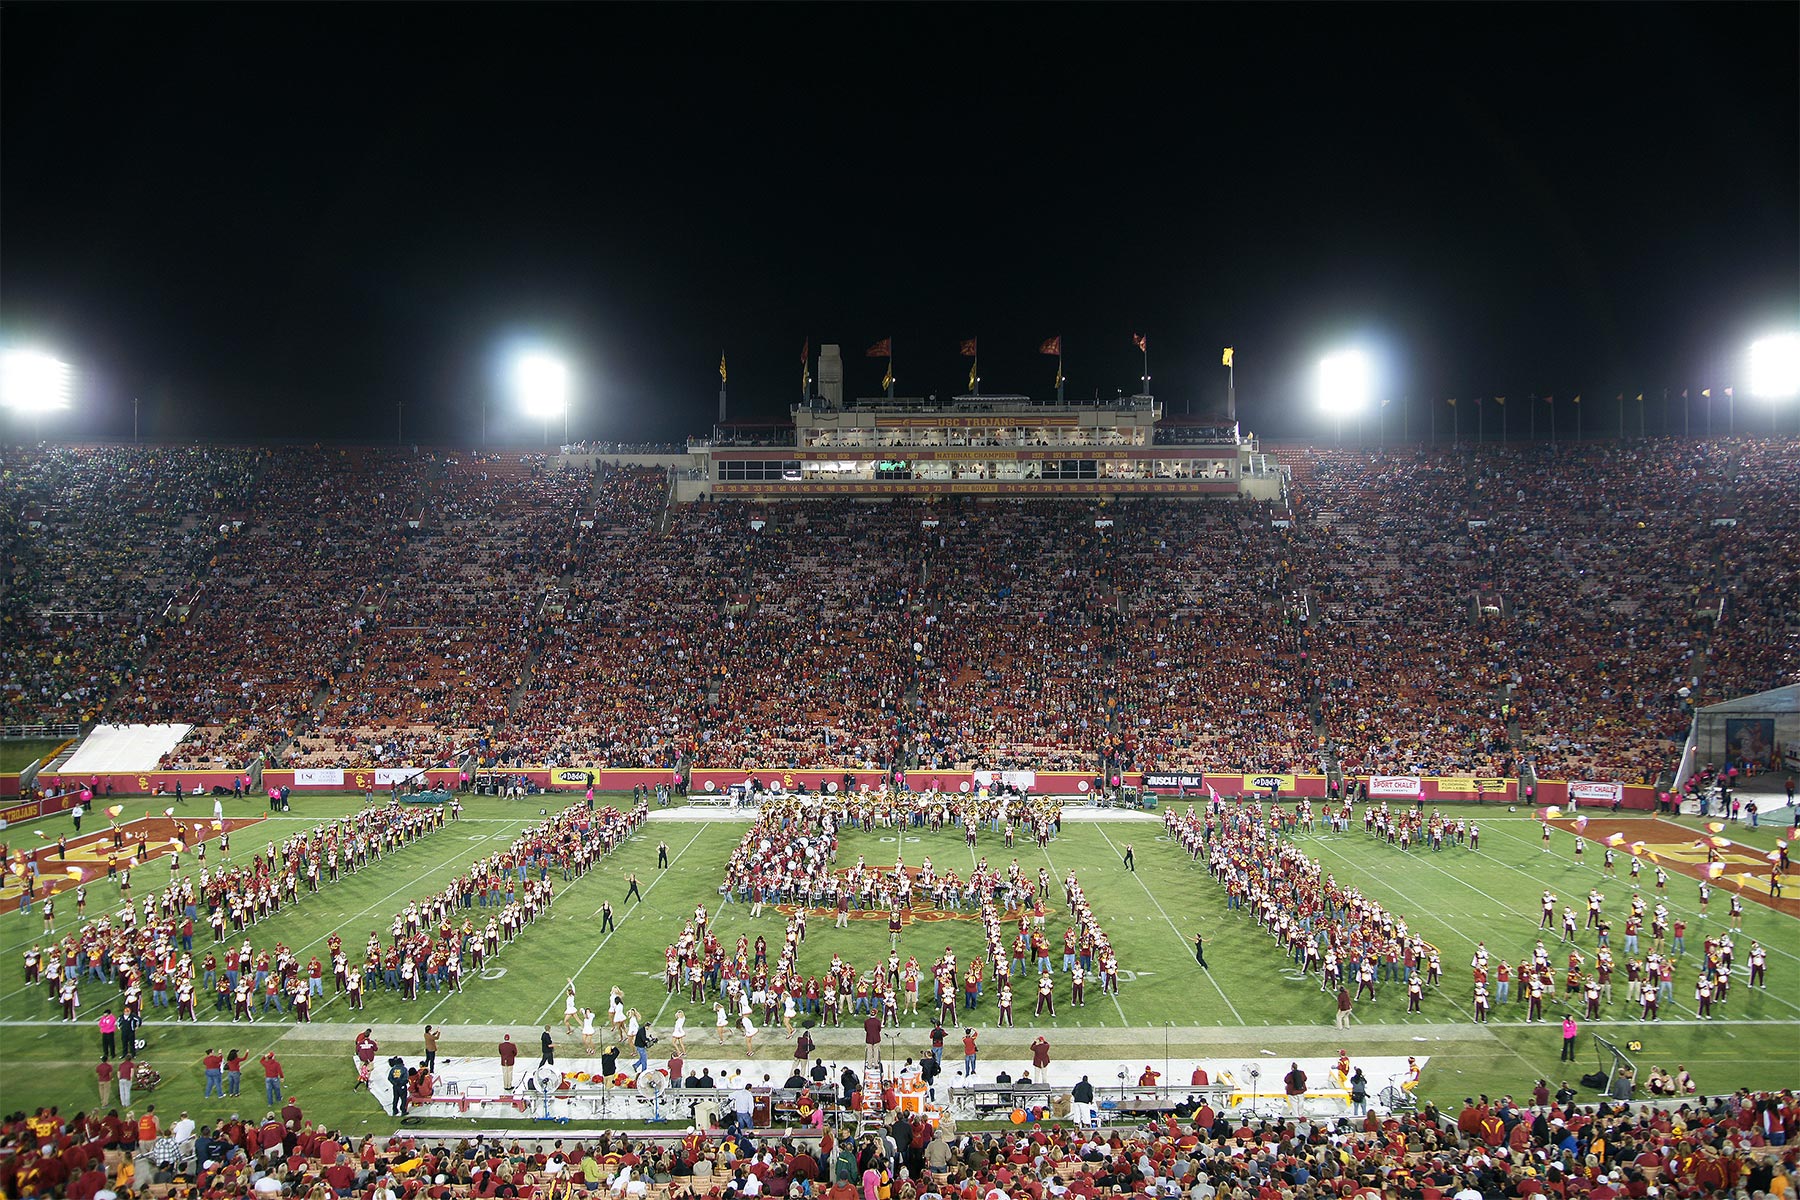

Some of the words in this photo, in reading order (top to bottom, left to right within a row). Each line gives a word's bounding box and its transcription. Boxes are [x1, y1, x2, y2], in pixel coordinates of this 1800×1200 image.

[938, 418, 960, 426] USC
[966, 418, 1016, 426] TROJANS
[1147, 777, 1178, 786] MUSCLE
[1373, 781, 1394, 789] SPORT
[1394, 780, 1417, 789] CHALET
[1594, 785, 1619, 793] CHALET
[6, 805, 37, 822] TROJANS
[1628, 1041, 1642, 1051] 20
[800, 1104, 811, 1116] 40
[35, 1122, 53, 1138] 58
